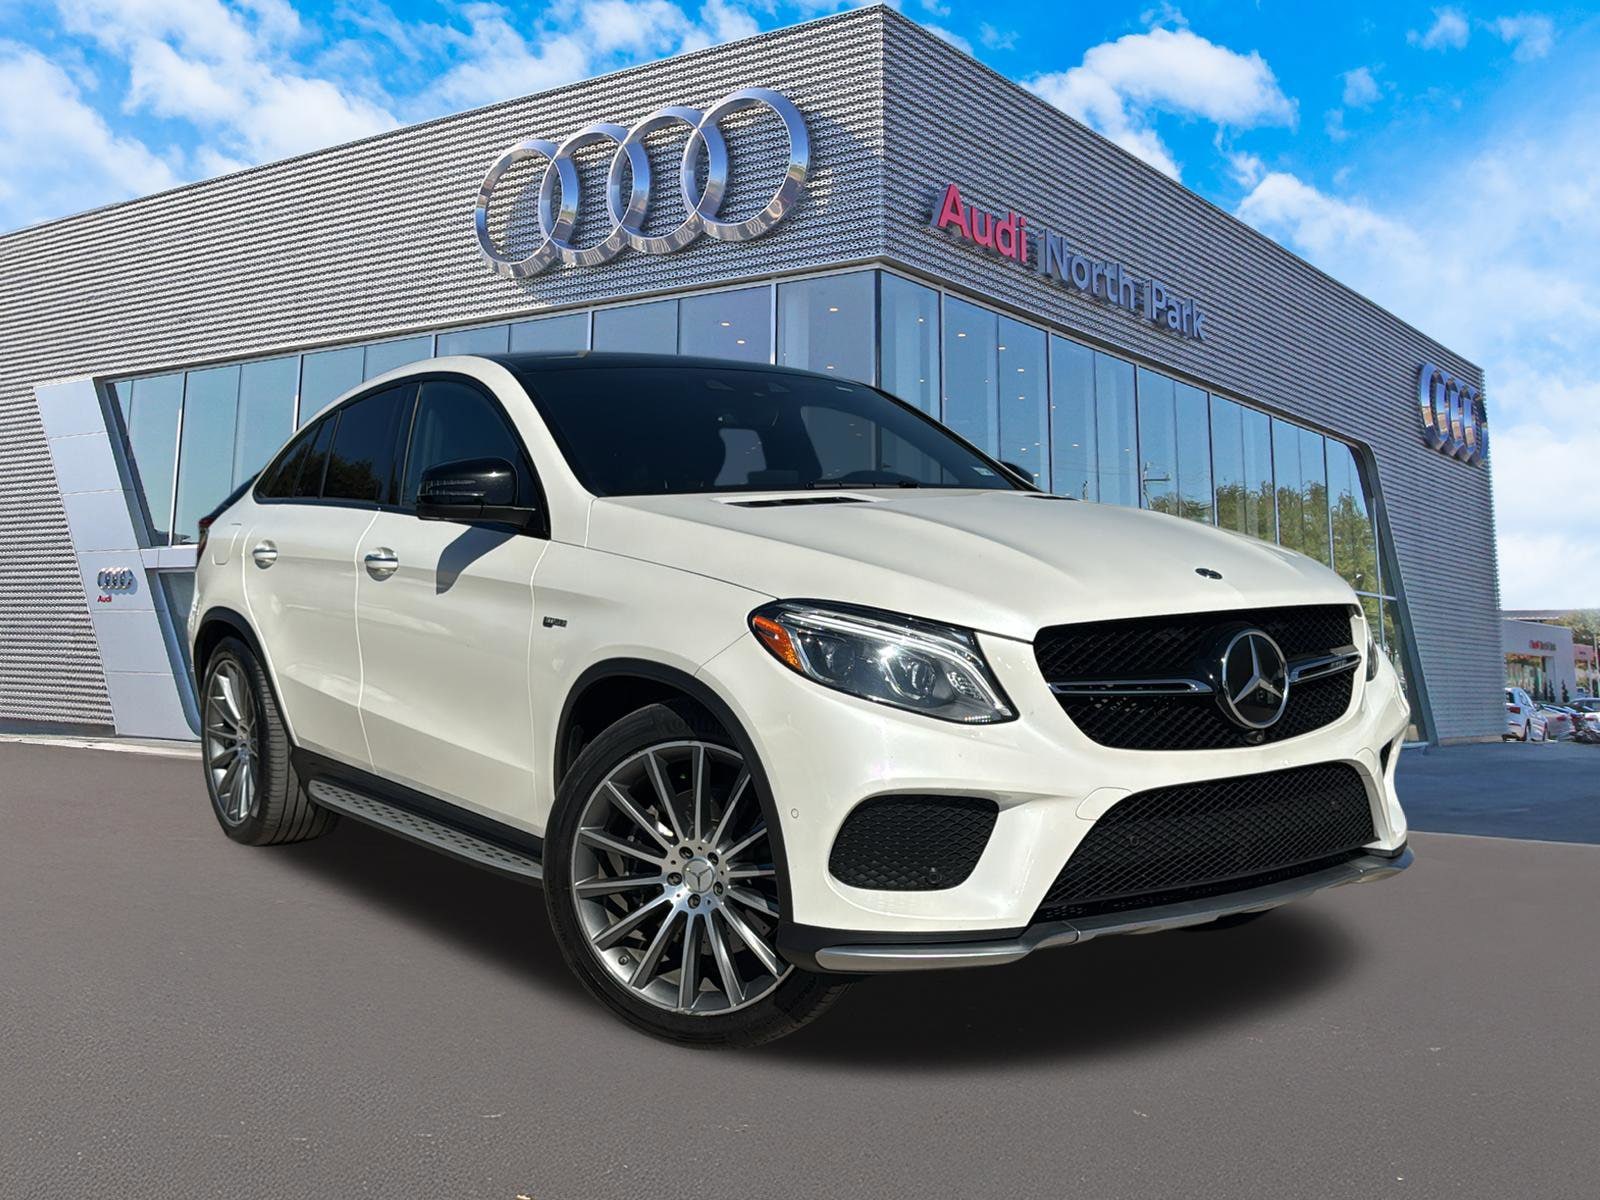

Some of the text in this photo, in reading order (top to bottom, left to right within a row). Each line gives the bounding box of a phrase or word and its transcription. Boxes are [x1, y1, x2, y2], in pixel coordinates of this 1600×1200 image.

[934, 183, 1207, 341] Audi North Park
